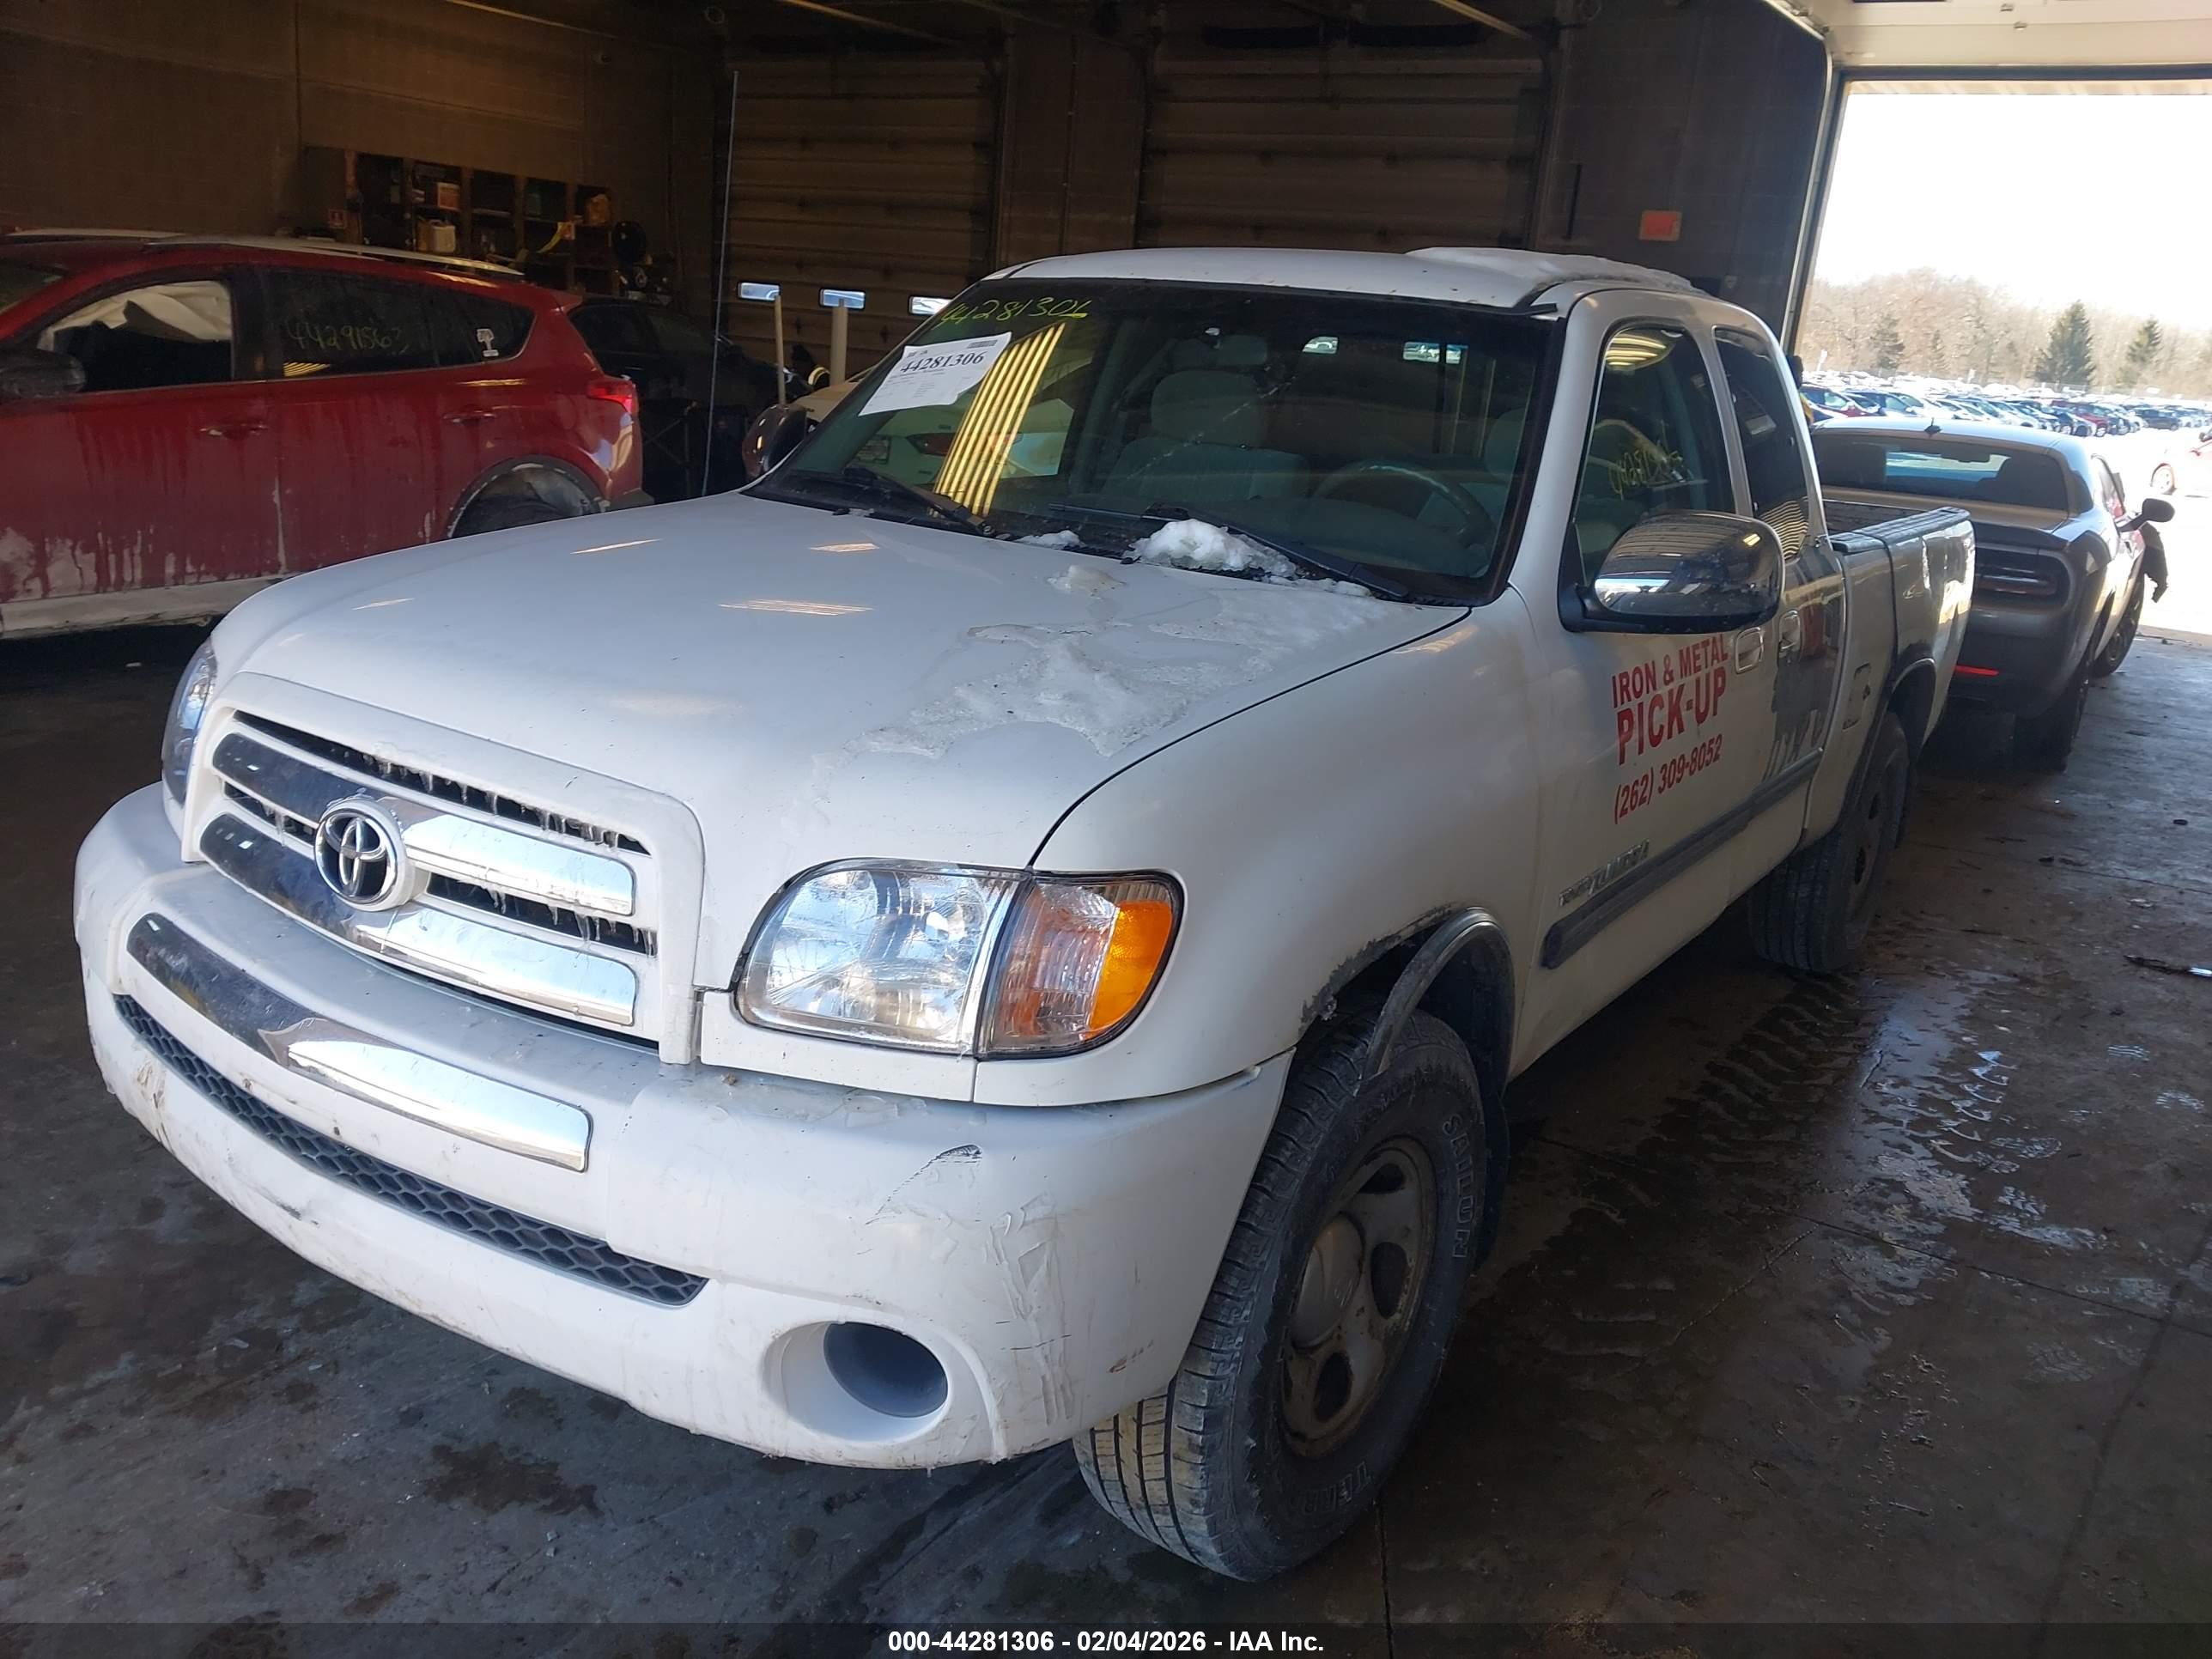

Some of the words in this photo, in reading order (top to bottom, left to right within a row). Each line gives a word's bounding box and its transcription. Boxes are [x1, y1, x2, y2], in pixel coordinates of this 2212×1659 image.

[900, 350, 988, 374] 44281306
[1611, 659, 1657, 708] IRON
[1663, 654, 1674, 686] &
[1679, 634, 1729, 679] METAL
[1617, 665, 1727, 765] PICK-UP
[1614, 767, 1654, 824] (262)
[1658, 733, 1723, 794] 309-8052
